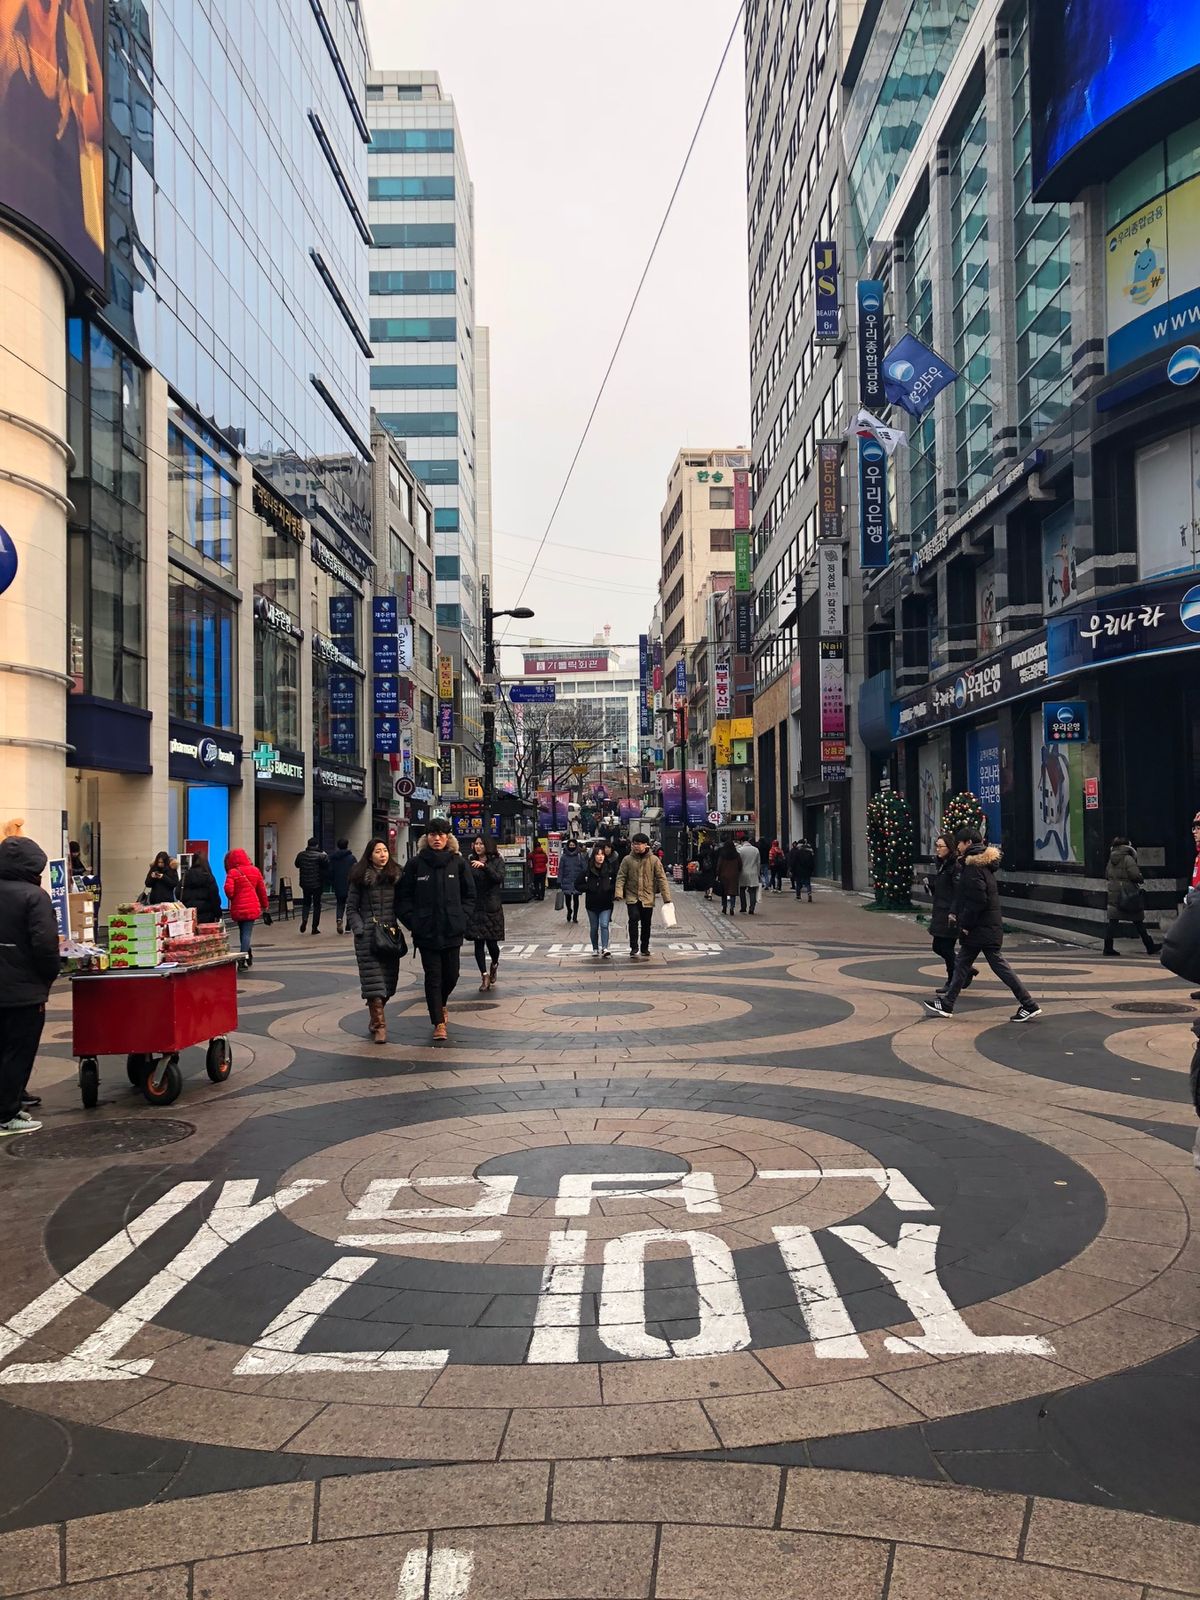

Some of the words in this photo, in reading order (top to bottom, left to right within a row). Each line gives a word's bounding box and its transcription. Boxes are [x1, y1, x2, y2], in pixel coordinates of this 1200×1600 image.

[1117, 205, 1164, 244] 우리종합금융
[865, 315, 879, 395] 우리종합금융
[909, 366, 944, 404] 우리은행
[864, 466, 883, 544] 우리은행
[1080, 604, 1166, 649] 우리나라
[398, 632, 407, 667] GALAXY
[822, 642, 843, 650] Nail
[441, 663, 451, 689] 부동산
[966, 663, 1001, 703] 우리은행
[715, 672, 729, 708] 부동산
[1052, 722, 1081, 732] 우리은행
[170, 738, 198, 759] pharmacy
[824, 747, 844, 755] 상품권
[274, 761, 304, 779] BAGUETTE
[467, 778, 480, 797] 담배
[980, 784, 1001, 804] 우리은행
[710, 812, 721, 824] 약
